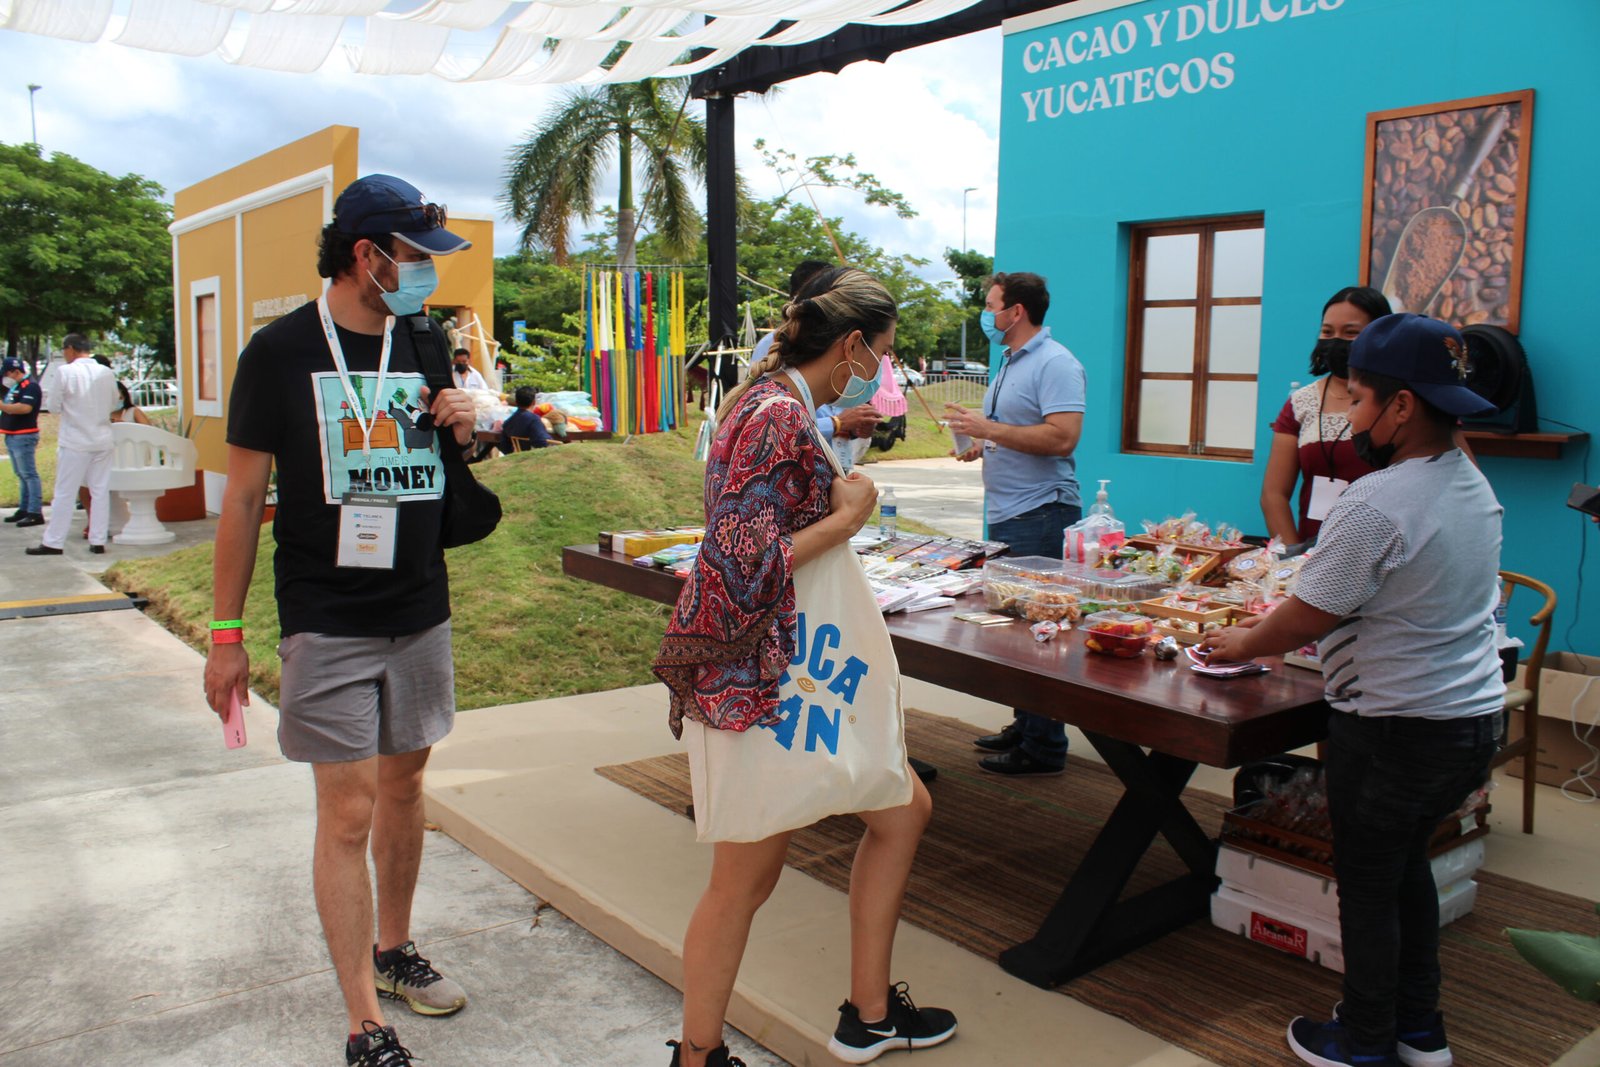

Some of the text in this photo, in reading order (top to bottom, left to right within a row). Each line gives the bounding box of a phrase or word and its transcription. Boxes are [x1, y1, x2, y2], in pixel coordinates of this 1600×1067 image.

[1023, 0, 1345, 74] CACAO Y DULC
[1021, 52, 1236, 122] YUCATECOS
[348, 465, 436, 492] MONEY
[379, 455, 409, 466] TIME IS
